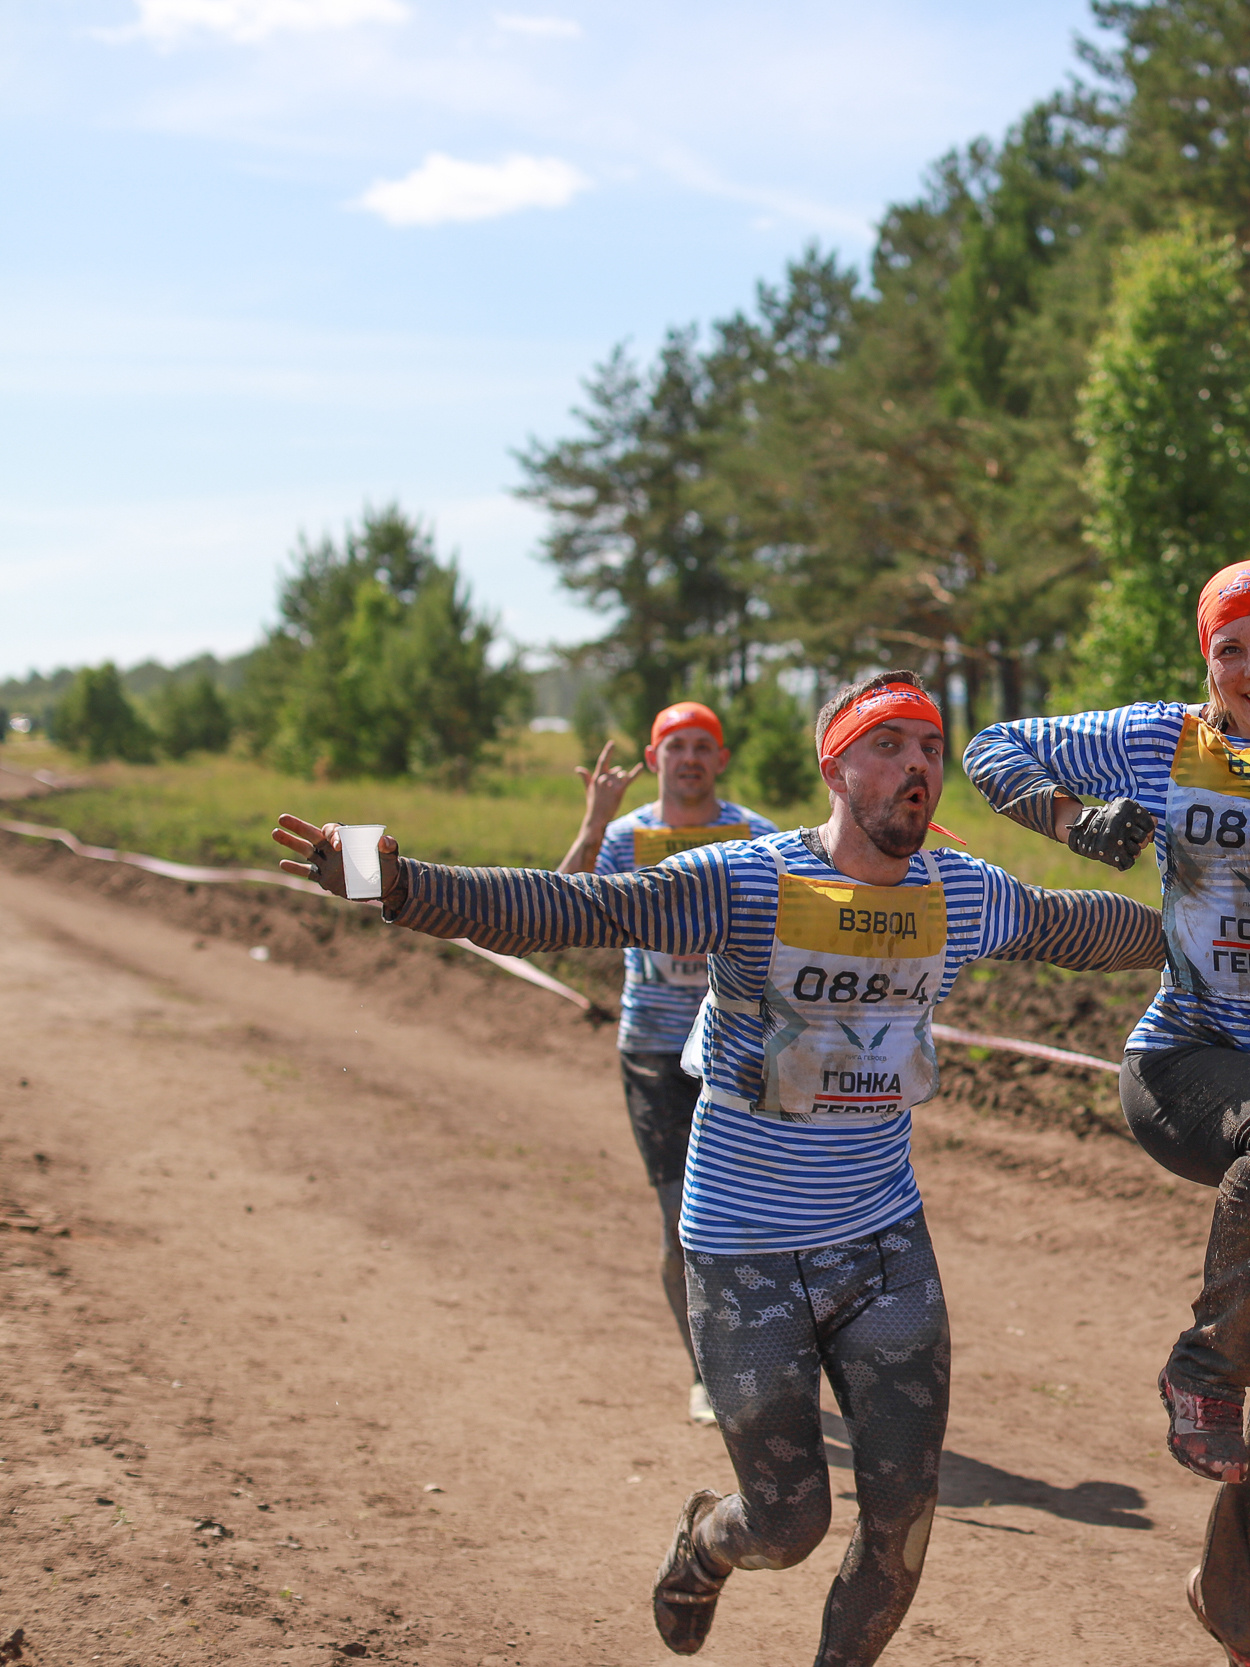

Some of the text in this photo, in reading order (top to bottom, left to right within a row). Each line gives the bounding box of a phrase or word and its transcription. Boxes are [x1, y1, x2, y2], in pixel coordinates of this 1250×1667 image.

[838, 907, 917, 939] ВЗВОД
[793, 965, 929, 1005] 088-4
[822, 1070, 901, 1094] ГОНКА
